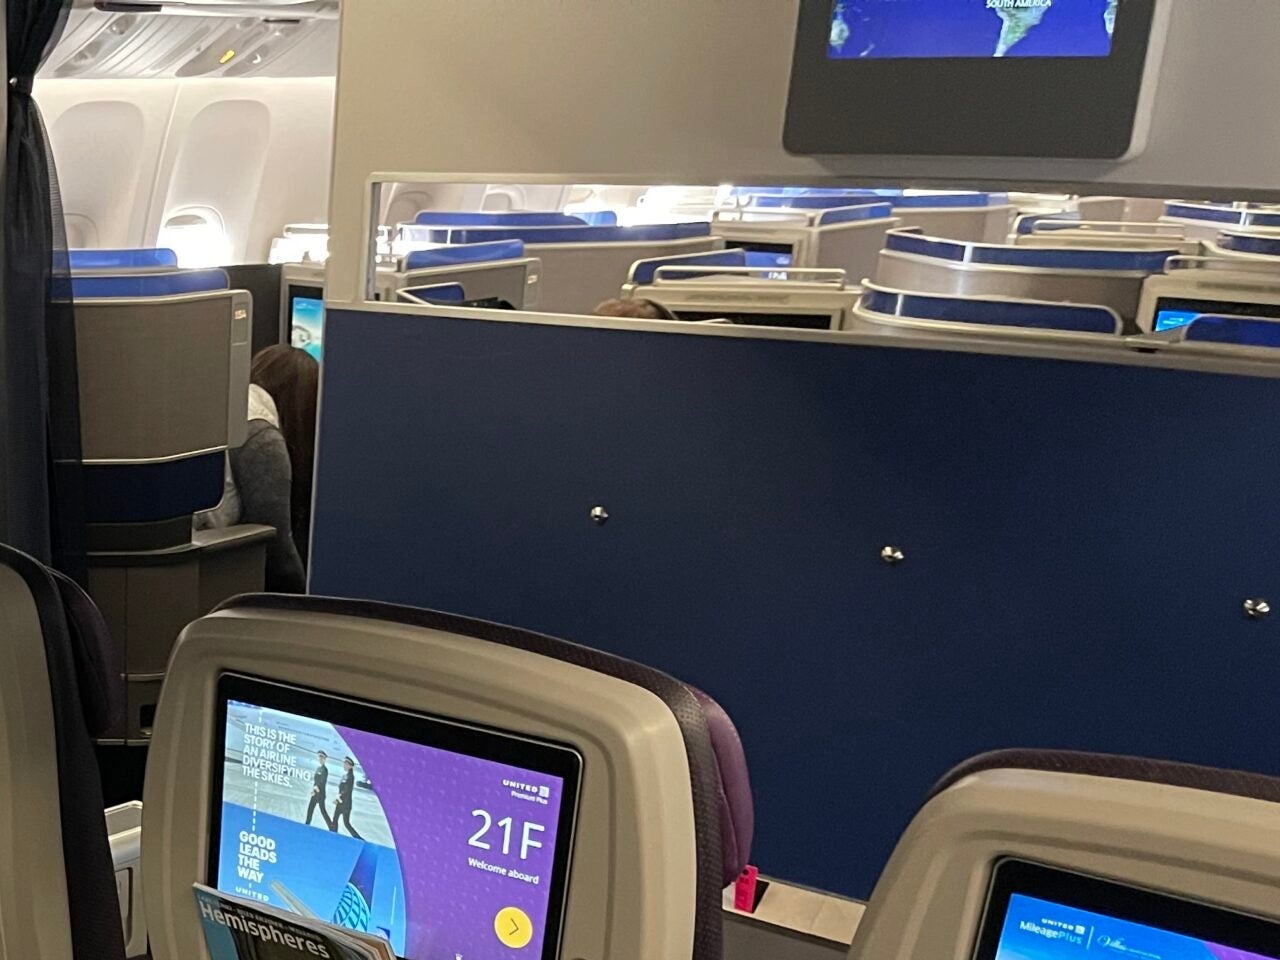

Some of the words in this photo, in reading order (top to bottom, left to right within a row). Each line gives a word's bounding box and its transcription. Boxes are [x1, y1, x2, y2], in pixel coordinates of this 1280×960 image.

[986, 0, 1018, 8] SOUTH
[243, 734, 276, 749] STORY
[276, 742, 290, 754] OF
[244, 722, 266, 737] THIS
[267, 728, 277, 740] IS
[278, 730, 297, 744] THE
[243, 745, 259, 757] AN
[259, 750, 297, 767] AIRLINE
[242, 755, 312, 781] DIVERSIFYING
[242, 766, 261, 780] THE
[261, 770, 293, 788] SKIES.
[503, 779, 538, 793] UNITED
[239, 830, 276, 850] GOOD
[468, 809, 545, 860] 21F
[238, 842, 277, 864] LEADS
[238, 854, 260, 871] THE
[237, 866, 264, 884] WAY
[468, 857, 507, 876] Welcome
[508, 869, 539, 885] aboard
[235, 886, 270, 902] UNITED
[199, 900, 331, 959] Hemispheres
[1019, 920, 1083, 945] MileagePlus
[1041, 918, 1074, 931] UNITED
